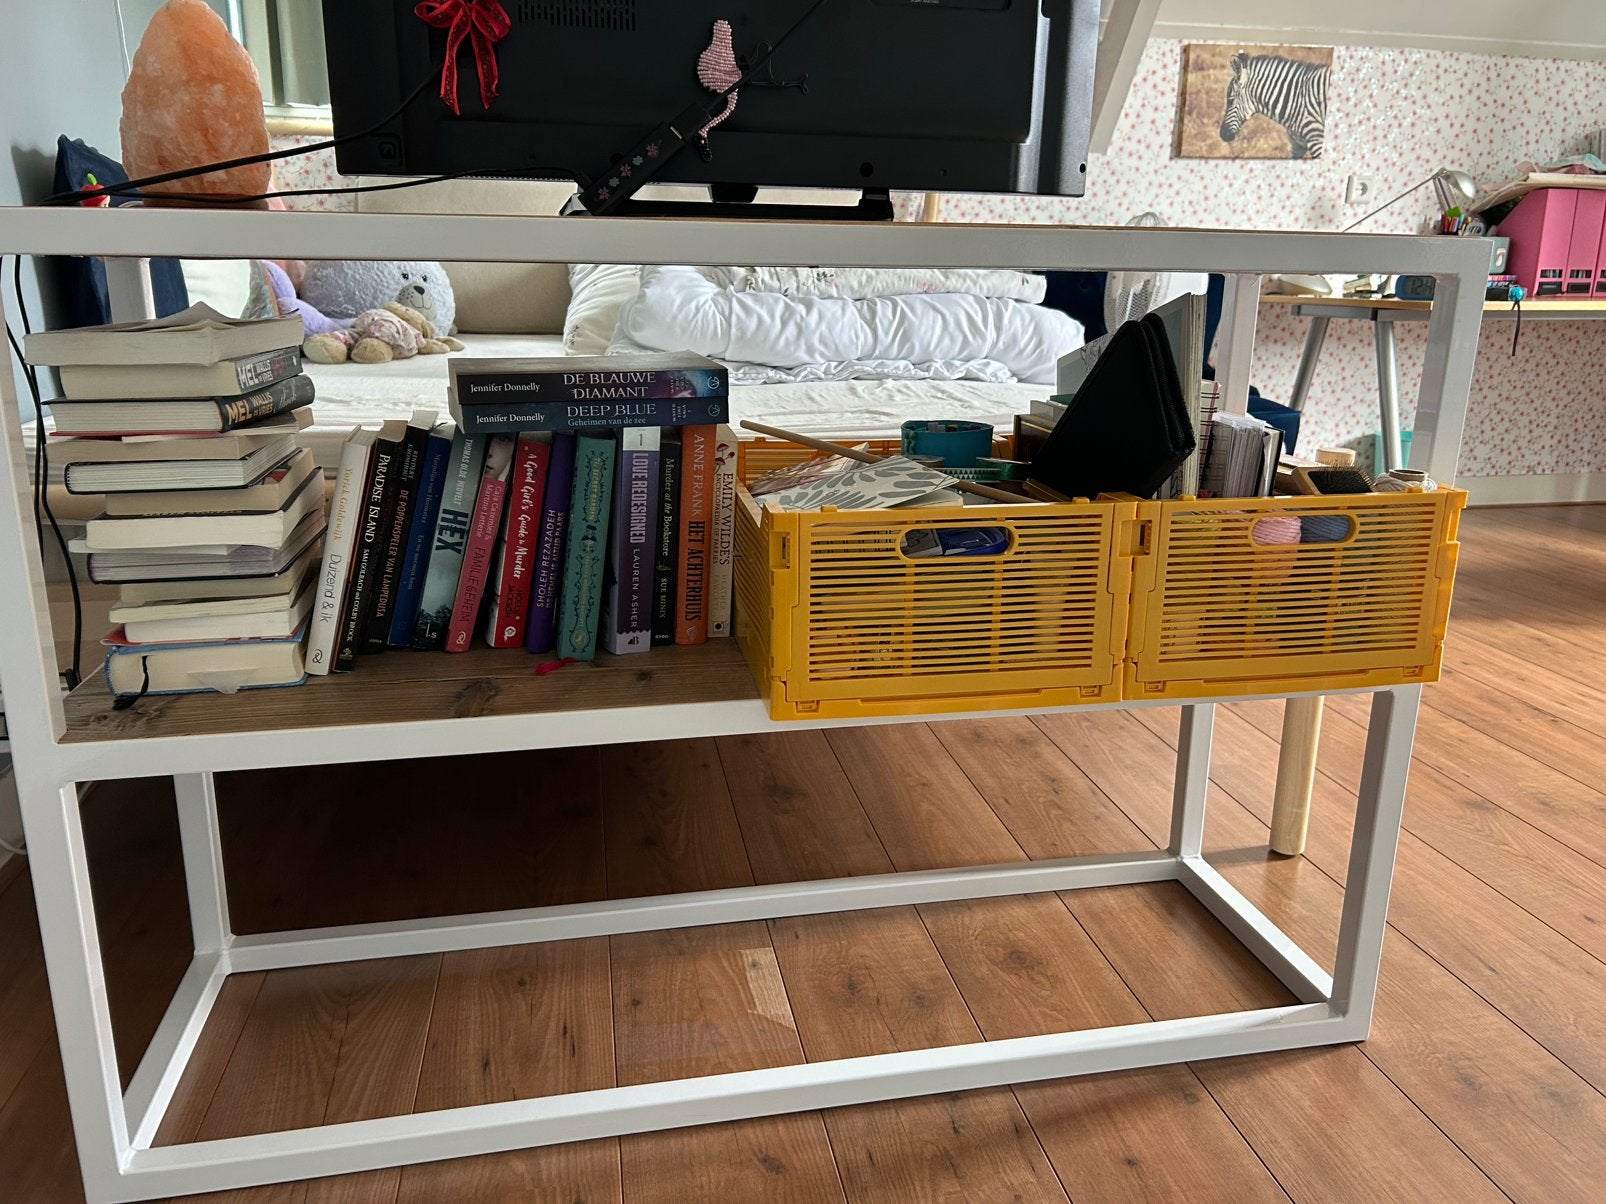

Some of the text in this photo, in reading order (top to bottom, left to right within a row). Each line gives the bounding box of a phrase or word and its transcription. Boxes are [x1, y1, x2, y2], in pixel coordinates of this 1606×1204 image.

[238, 364, 258, 389] MEL
[470, 382, 541, 393] Jennifer Donnelly
[563, 371, 657, 385] DE BLAUWE
[250, 391, 274, 408] WALLIS
[571, 386, 649, 399] DIAMANT
[225, 399, 253, 426] MEL
[259, 402, 274, 417] VRIES
[476, 412, 545, 424] Jennifer Donnelly
[567, 404, 657, 418] DEEP BLUE
[567, 418, 606, 427] Geheimen
[401, 443, 413, 482] KROMHOUT
[408, 450, 419, 479] RINDERT
[453, 439, 474, 505] THOMAS OLDE HEUVELT
[524, 461, 537, 483] Good
[691, 434, 705, 517] ANNE FRANK
[333, 465, 353, 541] Yorick Goldewijk
[364, 454, 391, 543] PARADISE ISLAND
[480, 483, 493, 511] Martine
[492, 486, 502, 502] Caja
[521, 485, 535, 511] Girl's
[630, 453, 649, 544] LOVE REDESIGNED
[662, 458, 675, 557] Murder at the Bookstore
[435, 509, 469, 555] HEX
[485, 502, 500, 534] Cazemier
[517, 514, 530, 538] Guide
[555, 512, 564, 536] PAARS
[712, 473, 722, 564] ENCYCLOPAEDIA OF FAERIES
[719, 473, 734, 565] EMILY WILDE'S
[362, 549, 370, 563] SAM
[375, 489, 409, 618] DE POPPENSPELER VAN LAMPEDUSA
[512, 546, 527, 580] Murder
[536, 509, 556, 608] SHOLEH REZAZADEH
[355, 563, 367, 591] GOLBACH
[631, 549, 641, 590] LAUREN
[685, 520, 705, 622] HET ACHTERHUIS
[319, 554, 342, 623] Duizend & ik
[504, 584, 515, 618] JACKSON
[659, 578, 668, 619] SUE MINIX
[350, 600, 360, 620] COLBY
[630, 594, 639, 629] ASHER
[346, 622, 356, 641] BROCK
